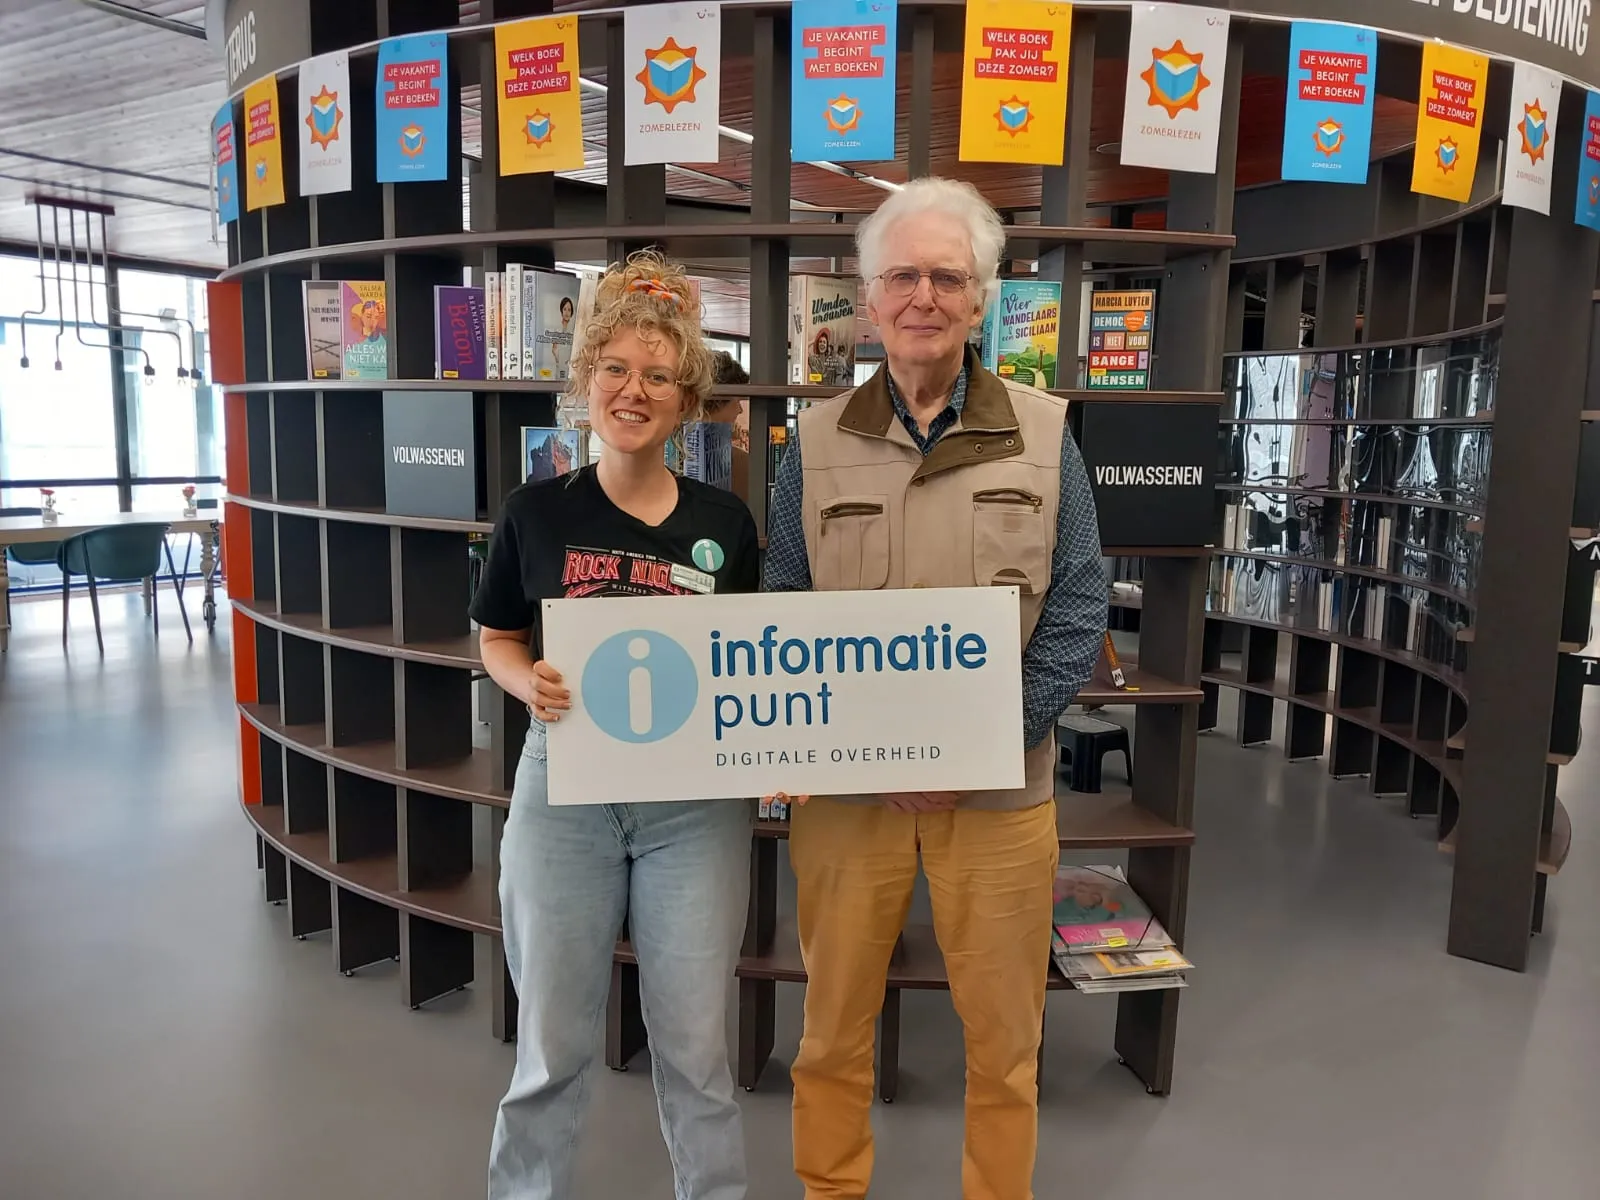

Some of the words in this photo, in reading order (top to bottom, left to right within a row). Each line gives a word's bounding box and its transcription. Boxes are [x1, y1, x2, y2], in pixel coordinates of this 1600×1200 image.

[1453, 0, 1591, 56] IENING
[808, 32, 822, 42] JE
[826, 30, 879, 41] VAKANTIE
[987, 31, 1016, 43] WELK
[1020, 33, 1048, 45] BOEK
[226, 11, 256, 86] TERUG
[512, 52, 535, 63] WELK
[537, 48, 560, 59] BOEK
[824, 46, 864, 57] BEGINT
[995, 48, 1016, 59] PAK
[1020, 50, 1038, 60] JIJ
[809, 63, 831, 73] MET
[834, 61, 878, 72] BOEKEN
[1304, 55, 1316, 65] JE
[1318, 56, 1362, 68] VAKANTIE
[388, 68, 398, 77] JE
[400, 64, 436, 75] VAKANTIE
[520, 66, 536, 76] PAK
[539, 64, 553, 74] JIJ
[978, 62, 1005, 74] DEZE
[1009, 64, 1054, 76] ZOMER?
[1316, 71, 1349, 83] BEGINT
[1435, 74, 1453, 87] WELK
[1455, 80, 1473, 92] BOEK
[399, 80, 426, 90] BEGINT
[507, 82, 528, 93] DEZE
[531, 76, 567, 89] ZOMER?
[1302, 85, 1322, 95] MET
[1325, 87, 1360, 98] BOEKEN
[388, 95, 404, 104] MET
[406, 92, 436, 103] BOEKEN
[1440, 91, 1453, 101] PAK
[1455, 96, 1466, 105] JIJ
[1428, 102, 1446, 114] DEZE
[1447, 107, 1474, 121] ZOMER?
[639, 122, 701, 134] ZOMERLEZEN
[1140, 125, 1201, 140] ZOMERLEZEN
[811, 292, 851, 315] Wonder
[1001, 292, 1032, 313] Vier
[1095, 296, 1122, 307] MARCIA
[1124, 295, 1150, 307] LUYTEN
[812, 306, 855, 325] vrouwen
[1002, 308, 1057, 326] WANDELAARS
[1094, 315, 1149, 327] DEMOCE
[448, 302, 475, 366] Beton
[1015, 322, 1057, 338] SICILIAAN
[1093, 336, 1101, 347] IS
[1128, 335, 1147, 346] VOOR
[345, 343, 375, 354] ALLES
[376, 344, 387, 354] W
[349, 354, 370, 364] NIET
[373, 355, 387, 364] KA
[1092, 355, 1135, 366] BANGE
[1090, 375, 1145, 386] MENSEN
[392, 446, 465, 467] VOLWASSENEN
[1095, 465, 1203, 485] VOLWASSENEN
[562, 549, 622, 586] ROCK
[629, 557, 694, 595] NIG
[611, 583, 648, 594] WITNESS
[710, 623, 987, 677] informatie
[714, 682, 832, 741] punt
[716, 750, 817, 766] DIGITALE
[831, 746, 941, 763] OVERHEID
